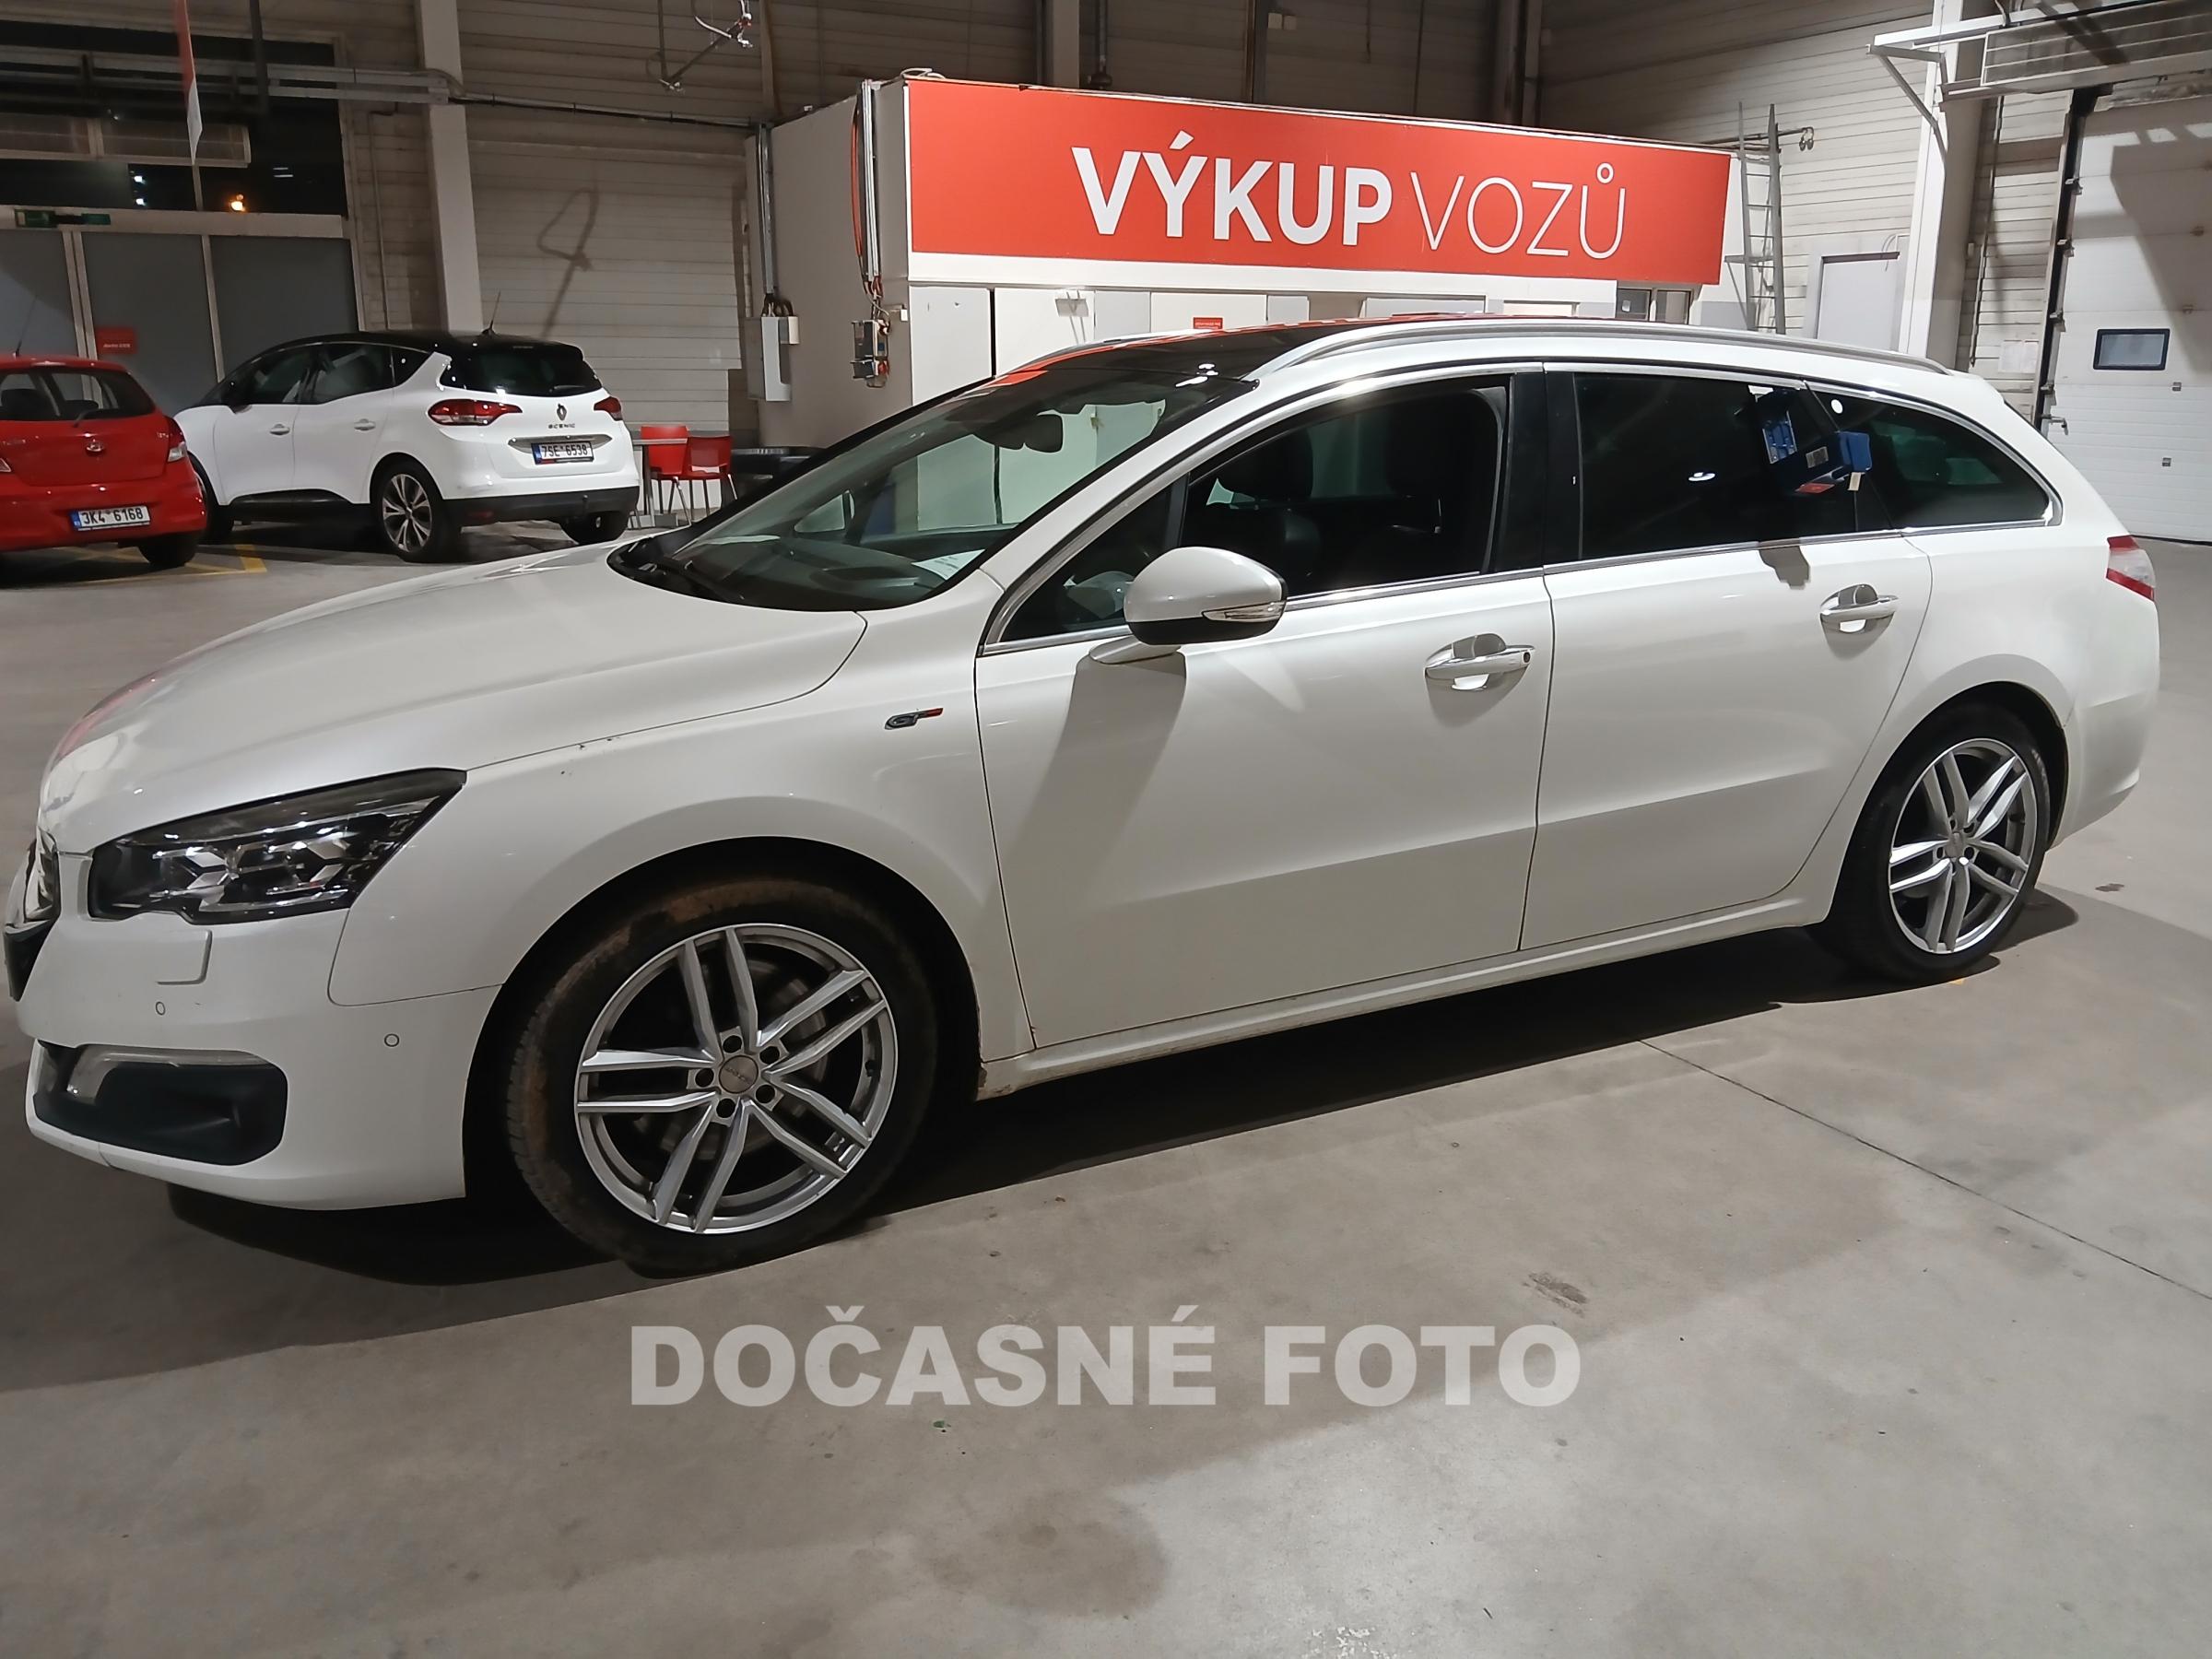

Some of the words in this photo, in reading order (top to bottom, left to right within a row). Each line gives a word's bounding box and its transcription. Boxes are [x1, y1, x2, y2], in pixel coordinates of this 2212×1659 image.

[1071, 130, 1393, 246] VÝKUP
[1410, 162, 1626, 259] VOZŮ
[541, 445, 560, 457] 7SE
[565, 443, 588, 456] 6538
[81, 512, 106, 524] 3K4
[112, 507, 144, 522] 6168
